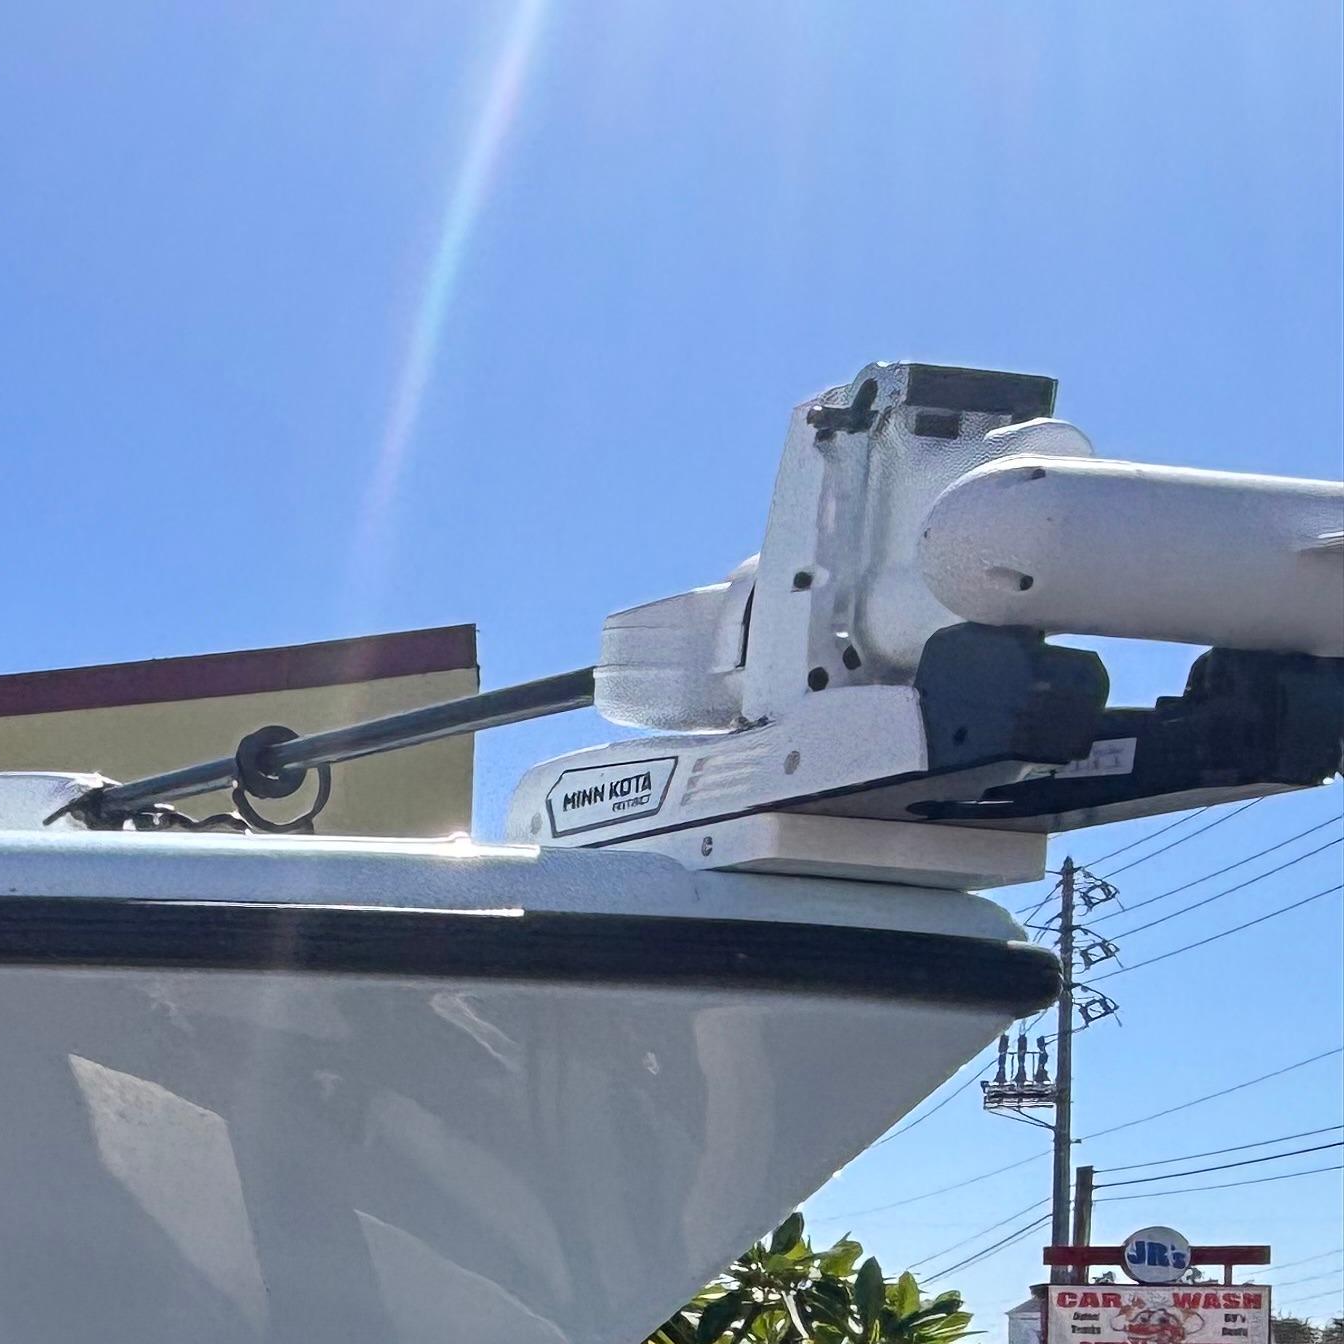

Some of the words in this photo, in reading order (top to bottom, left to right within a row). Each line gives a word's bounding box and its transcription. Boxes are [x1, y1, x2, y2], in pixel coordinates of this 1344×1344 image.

[562, 783, 605, 812] MINN
[608, 771, 652, 801] KOTA
[1056, 1291, 1123, 1309] CAR
[1172, 1292, 1263, 1310] WASH
